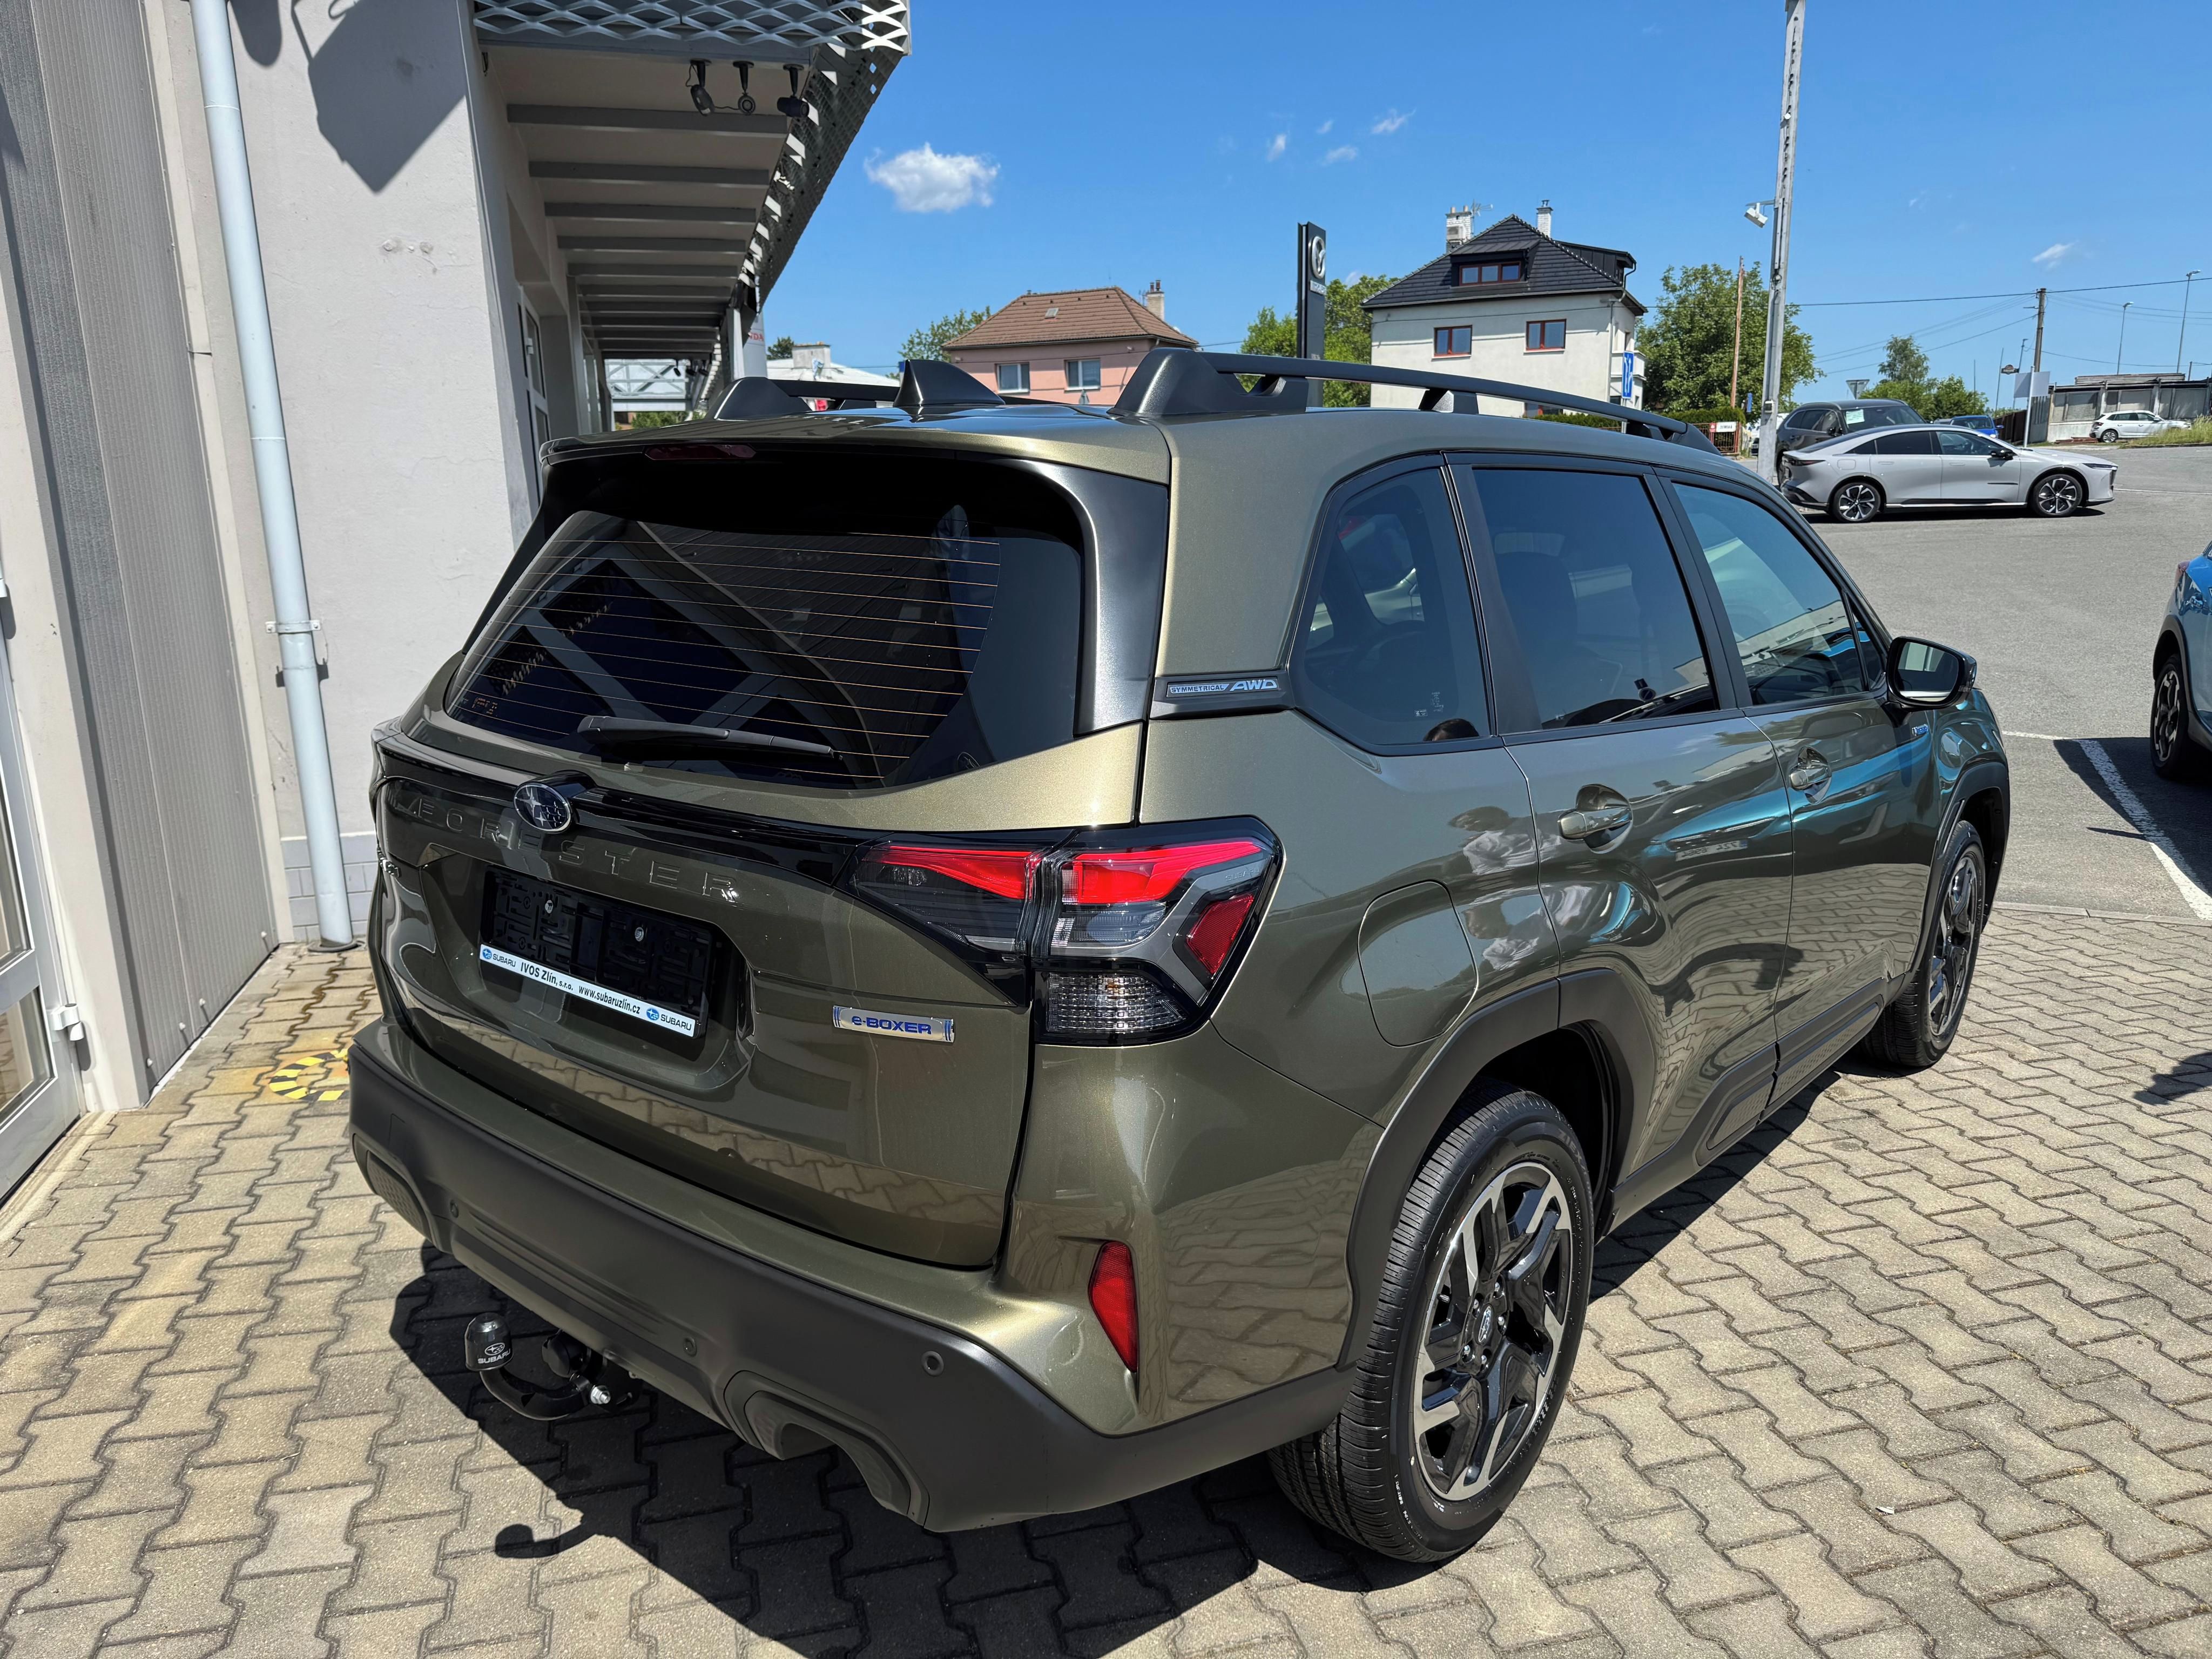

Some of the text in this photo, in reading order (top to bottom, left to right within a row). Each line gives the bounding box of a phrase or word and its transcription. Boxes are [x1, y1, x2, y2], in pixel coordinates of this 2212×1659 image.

[1171, 679, 1278, 693] SYMMETRICAL AWD
[418, 795, 739, 902] FORESTER
[493, 953, 692, 1031] SUBARU IVOS Zlín, s.r.o. www.subaruzlin.cz SUBARU
[851, 1015, 932, 1035] e-BOXER
[477, 1348, 511, 1364] SUBARU
